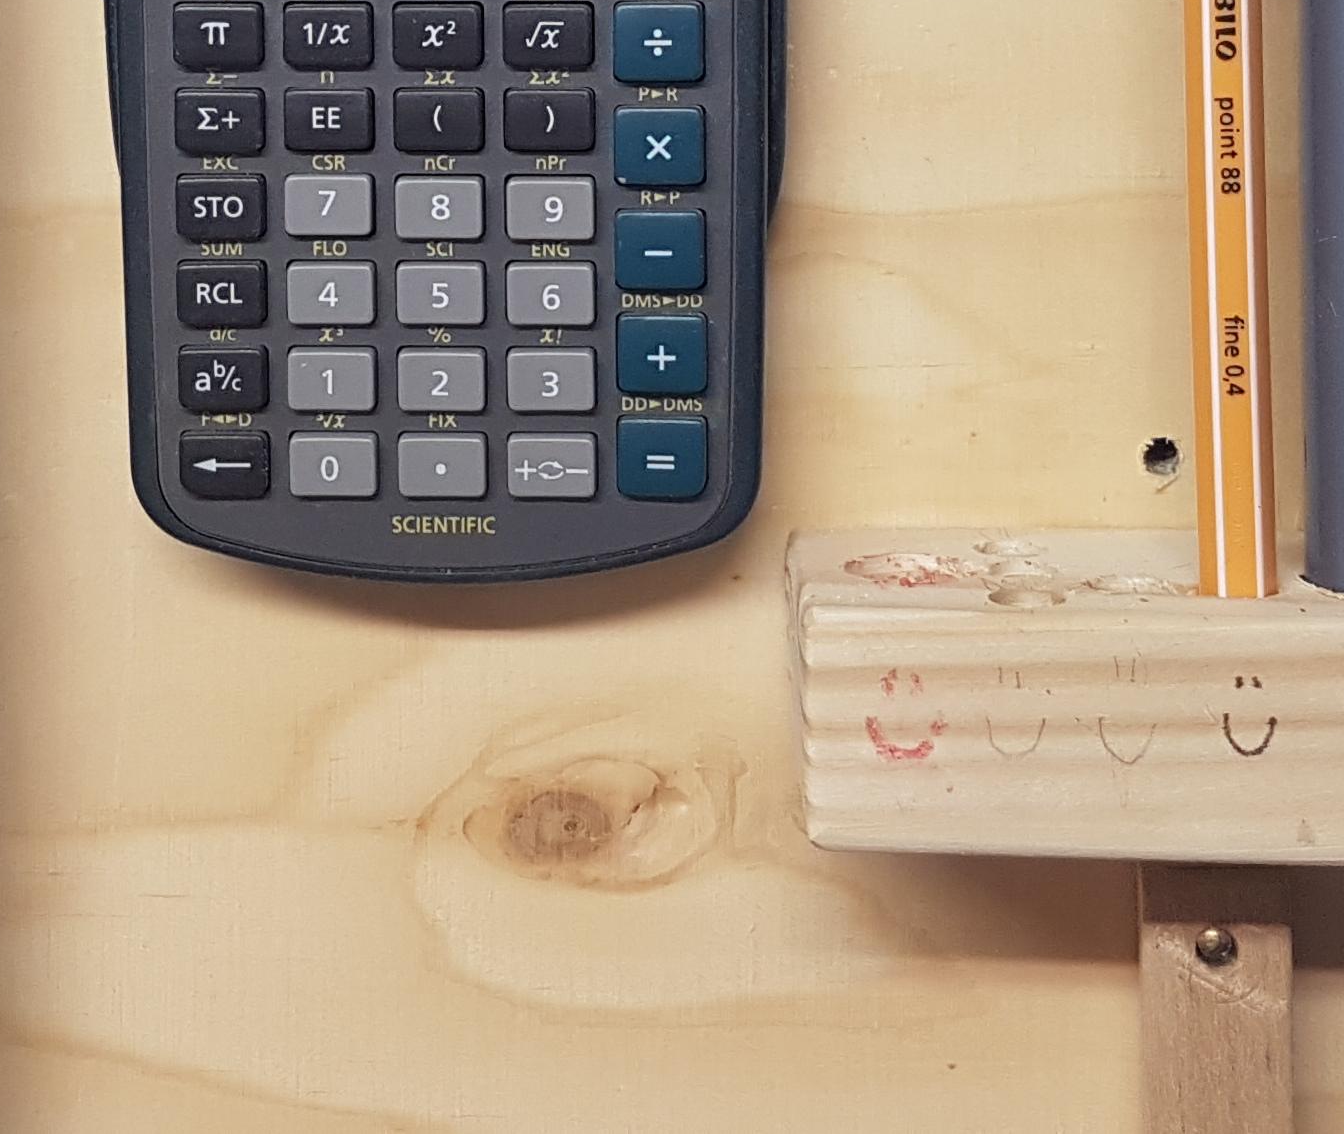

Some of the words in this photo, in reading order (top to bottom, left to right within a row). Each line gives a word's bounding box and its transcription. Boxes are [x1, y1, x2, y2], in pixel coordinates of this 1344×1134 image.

[303, 22, 350, 46] 1/x
[311, 107, 341, 129] EE
[1214, 96, 1239, 161] point
[202, 157, 240, 171] EXC
[312, 155, 346, 171] CSR
[424, 155, 456, 171] nCr
[535, 155, 567, 171] nPr
[1220, 165, 1242, 197] 88
[193, 196, 244, 219] STO
[317, 191, 337, 216] 7
[430, 196, 450, 222] 8
[544, 197, 563, 223] 9
[201, 241, 243, 256] SUM
[313, 240, 347, 256] FLO
[426, 242, 454, 257] SCI
[531, 243, 570, 258] ENG
[196, 283, 243, 304] RCL
[318, 282, 339, 307] 4
[431, 282, 449, 309] 5
[542, 284, 561, 310] 6
[1224, 315, 1246, 359] fine
[321, 369, 334, 395] 1
[431, 371, 449, 396] 2
[541, 372, 560, 398] 3
[1224, 365, 1246, 397] 0,4
[429, 414, 457, 428] FIX
[320, 456, 339, 481] 0
[391, 515, 496, 535] SCIENTIFIC
